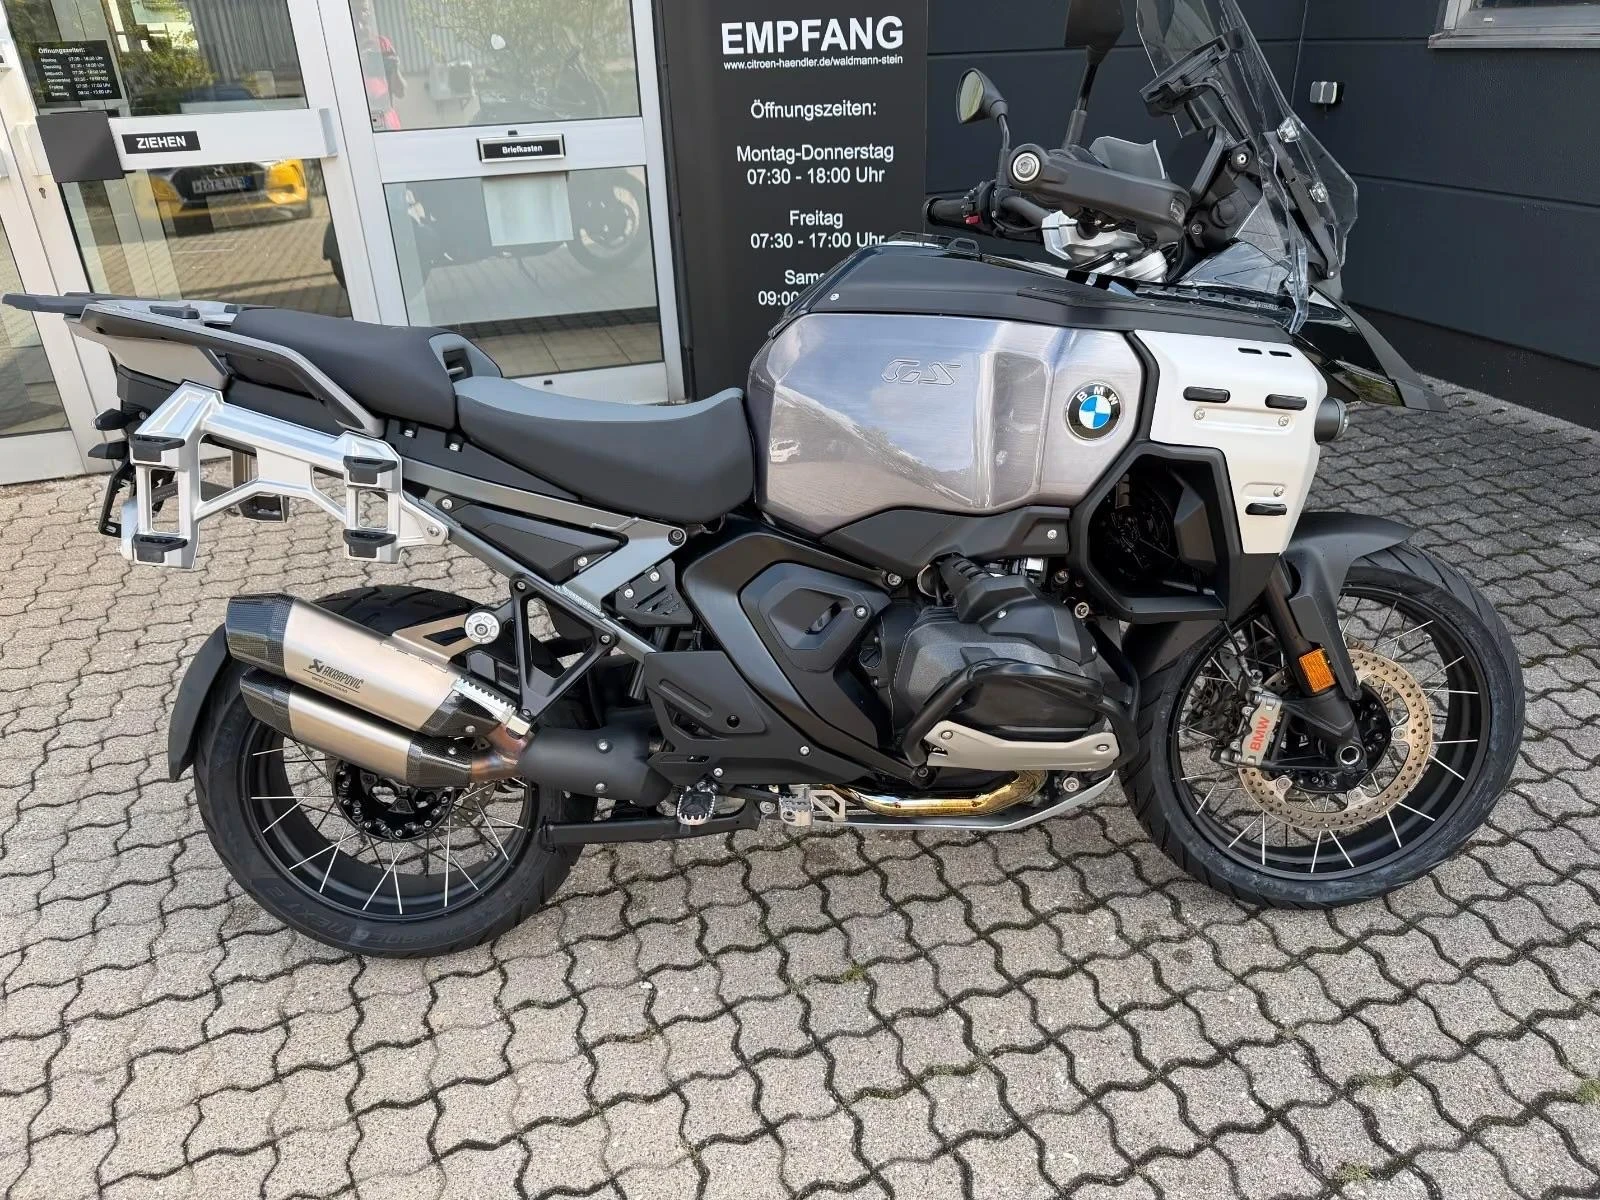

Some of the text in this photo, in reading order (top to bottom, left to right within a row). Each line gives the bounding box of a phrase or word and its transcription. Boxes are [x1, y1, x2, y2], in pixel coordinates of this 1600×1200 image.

[721, 15, 904, 55] EMPFANG
[723, 54, 903, 70] www.citroen-haendler.de/waldmann-stein
[750, 99, 877, 121] Öffnungszeiten:
[136, 135, 187, 150] ZIEHEN
[502, 145, 543, 154] Briefkasten
[736, 143, 894, 165] Montag-Donnerstag
[747, 168, 791, 185] 07:30
[807, 166, 850, 184] 18:00
[856, 166, 886, 183] Uhr
[789, 210, 844, 229] Freitag
[750, 233, 793, 249] 07:30
[808, 232, 852, 248] 17:00
[856, 231, 885, 248] Uhr
[881, 358, 963, 386] GS
[1076, 385, 1119, 406] BMW
[1250, 716, 1270, 751] BMW
